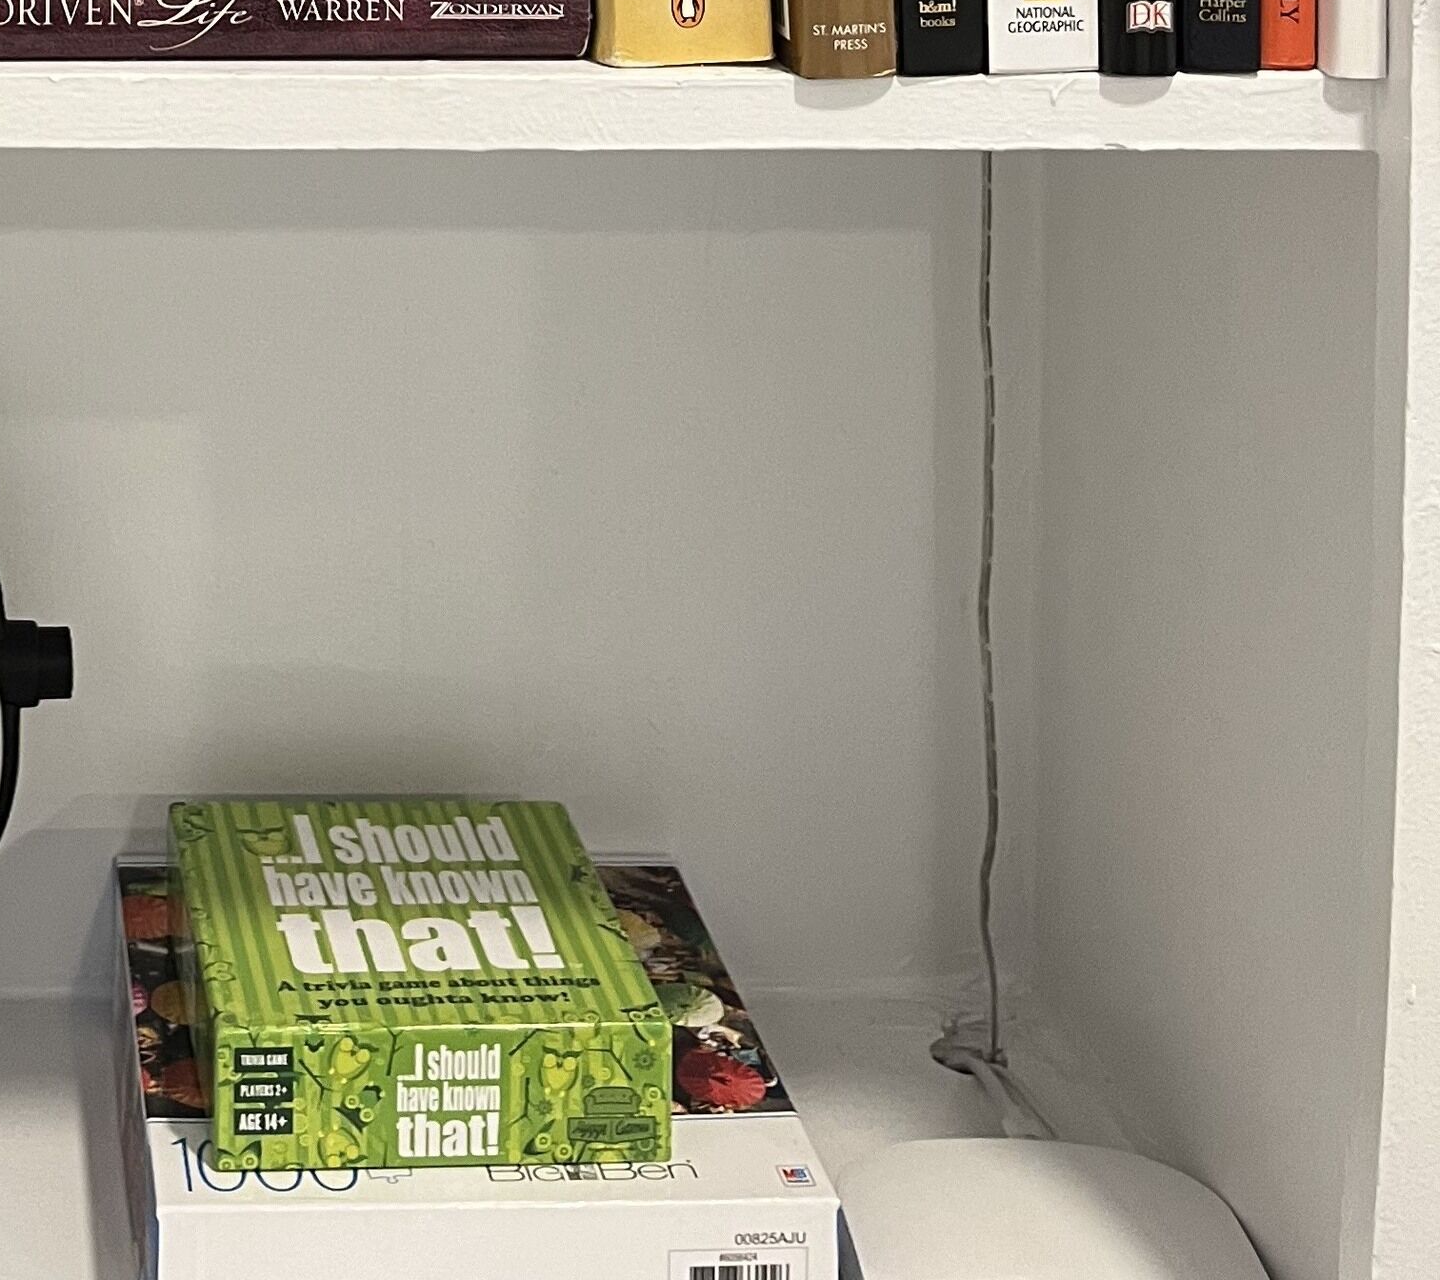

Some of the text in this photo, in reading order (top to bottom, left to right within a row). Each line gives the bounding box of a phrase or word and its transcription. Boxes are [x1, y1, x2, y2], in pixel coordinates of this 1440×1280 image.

[429, 0, 566, 20] ZONDERVAN
[1015, 6, 1076, 20] NATIONAL
[1007, 19, 1085, 34] GEOGRAPHIC
[328, 815, 520, 864] should
[262, 865, 539, 907] have known
[275, 905, 565, 974] that!
[303, 975, 601, 993] trivia game about things
